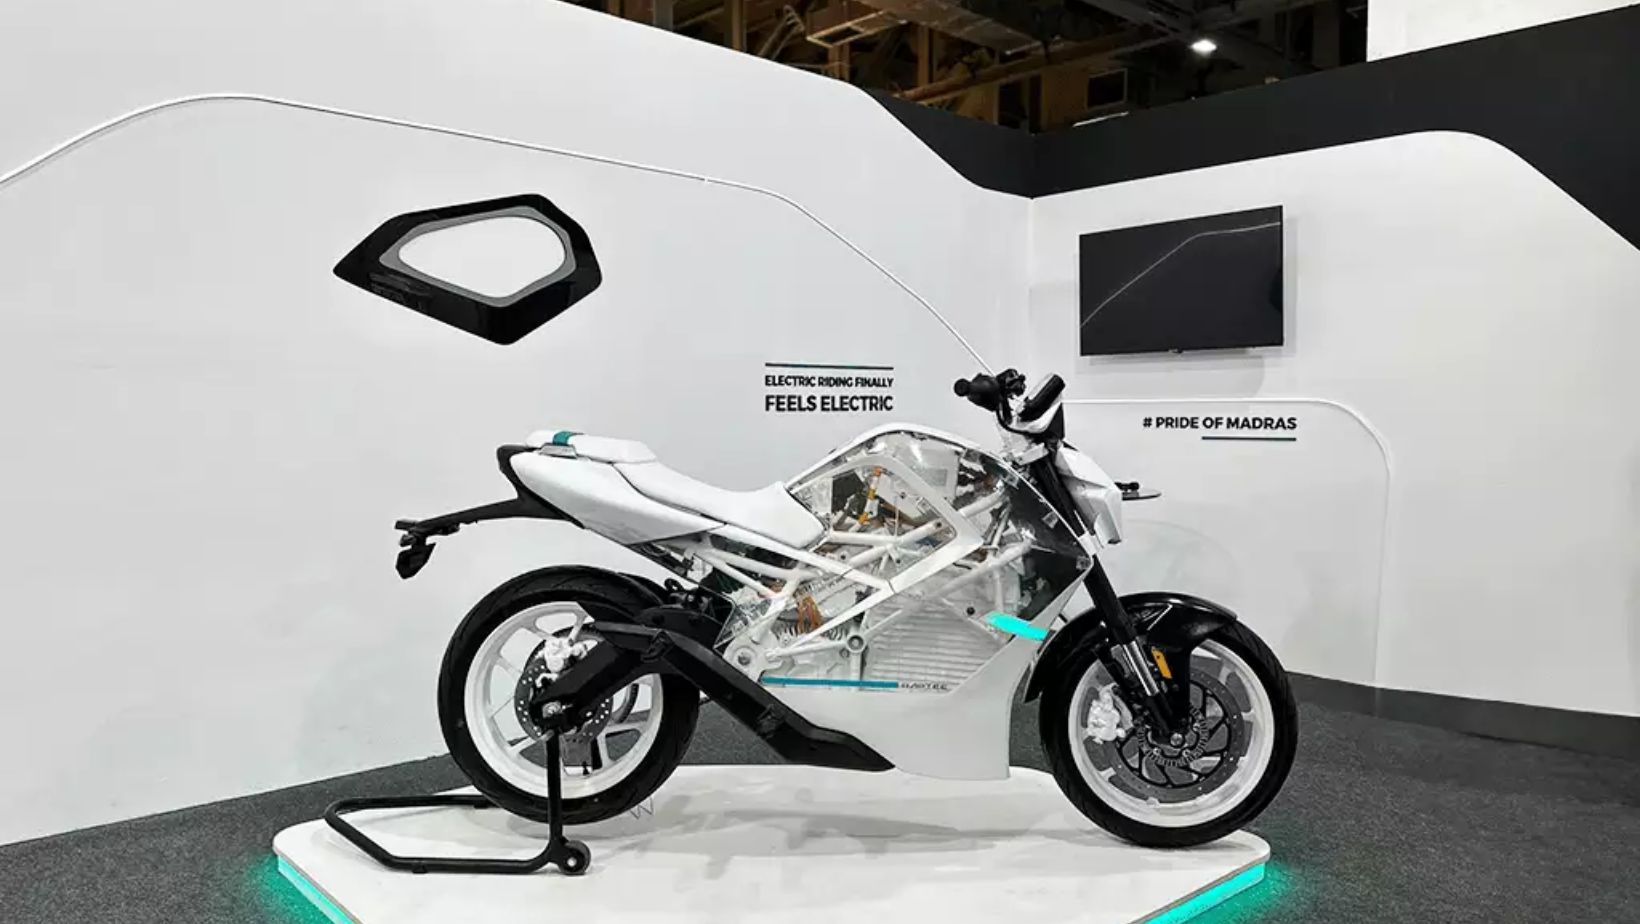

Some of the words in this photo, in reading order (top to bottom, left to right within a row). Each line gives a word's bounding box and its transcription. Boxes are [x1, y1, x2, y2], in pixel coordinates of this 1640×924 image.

[765, 375, 816, 387] ELECTRIC
[818, 376, 853, 388] RIDING
[855, 377, 894, 388] FINALLY
[765, 395, 817, 411] FEELS
[820, 396, 893, 412] ELECTRIC
[1142, 416, 1153, 428] #
[1156, 416, 1199, 429] PRIDE
[1202, 416, 1224, 429] OF
[1226, 417, 1298, 430] MADRAS
